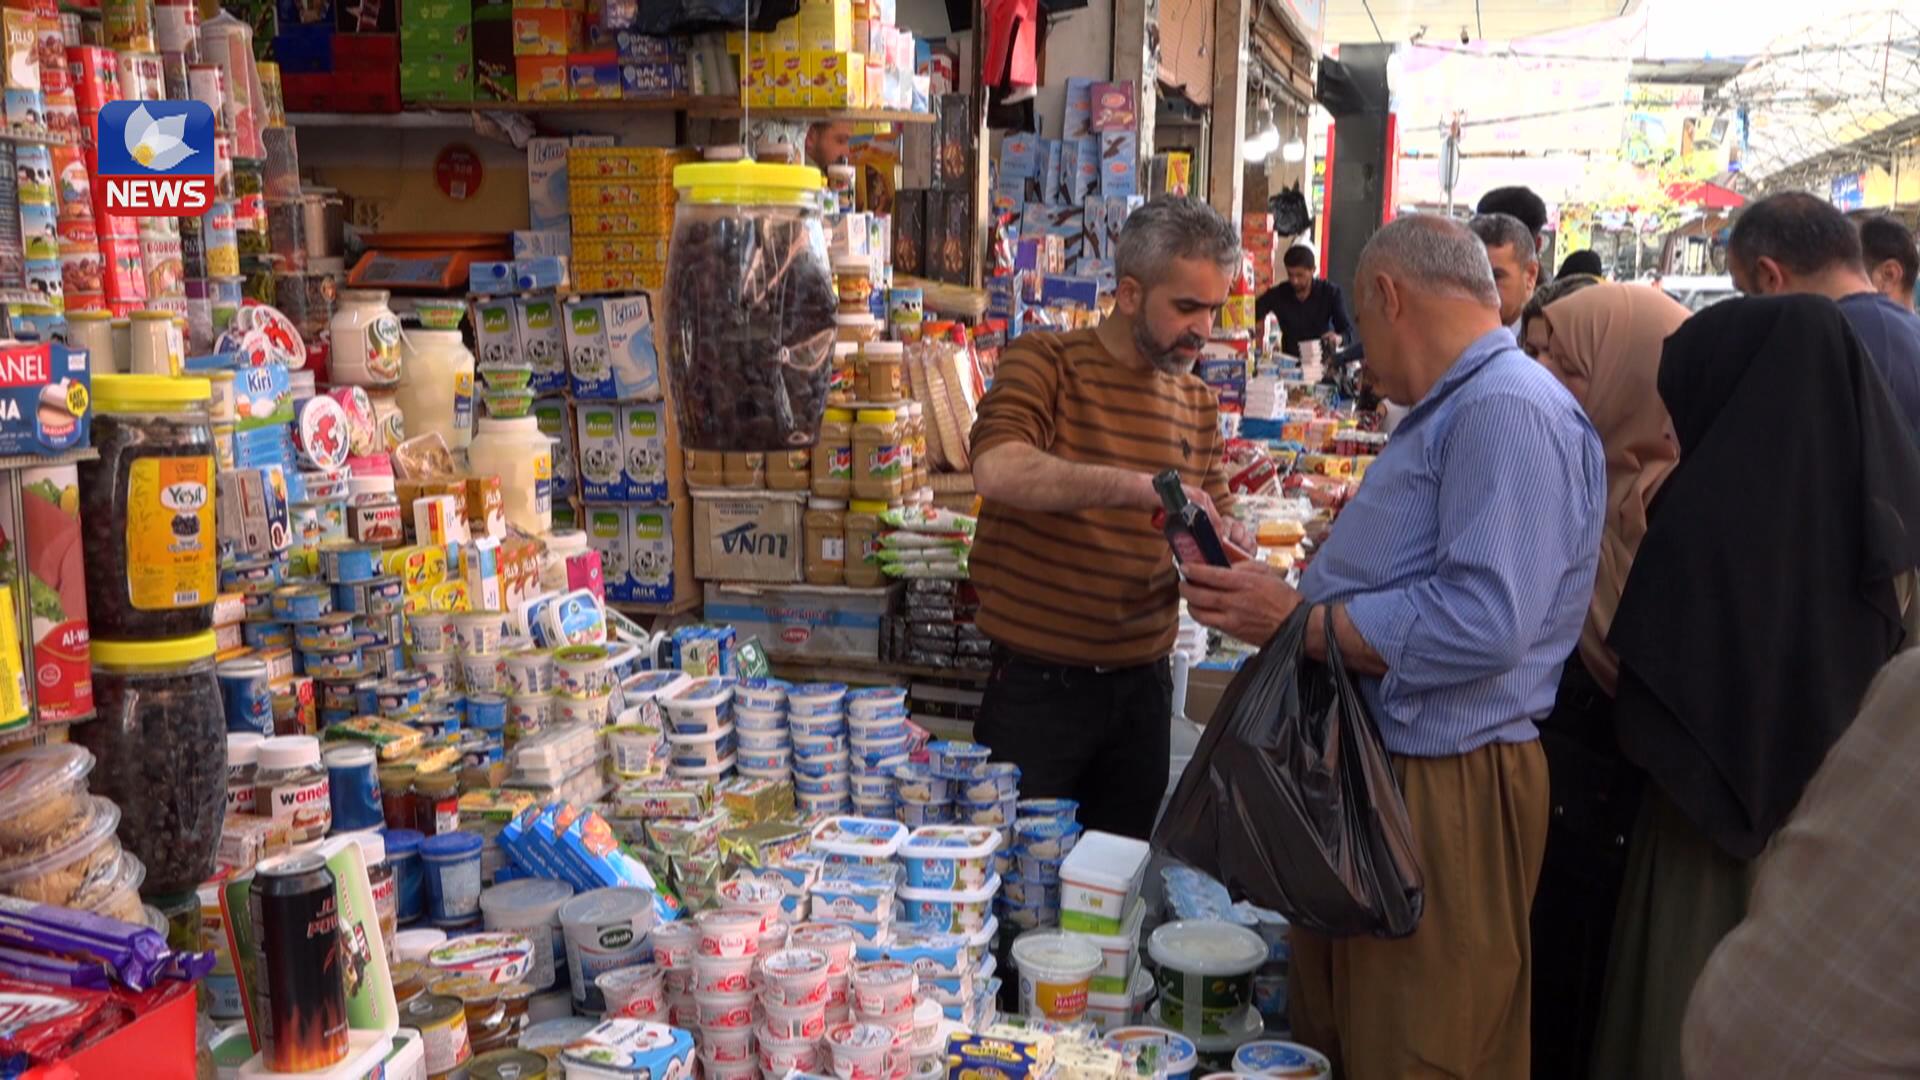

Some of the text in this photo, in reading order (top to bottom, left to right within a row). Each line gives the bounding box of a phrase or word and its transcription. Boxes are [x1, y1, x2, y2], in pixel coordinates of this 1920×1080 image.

[247, 368, 272, 392] Kiri
[584, 485, 608, 495] MILK
[628, 485, 653, 495] MILK
[721, 531, 788, 558] LUNA
[632, 586, 656, 597] MILK
